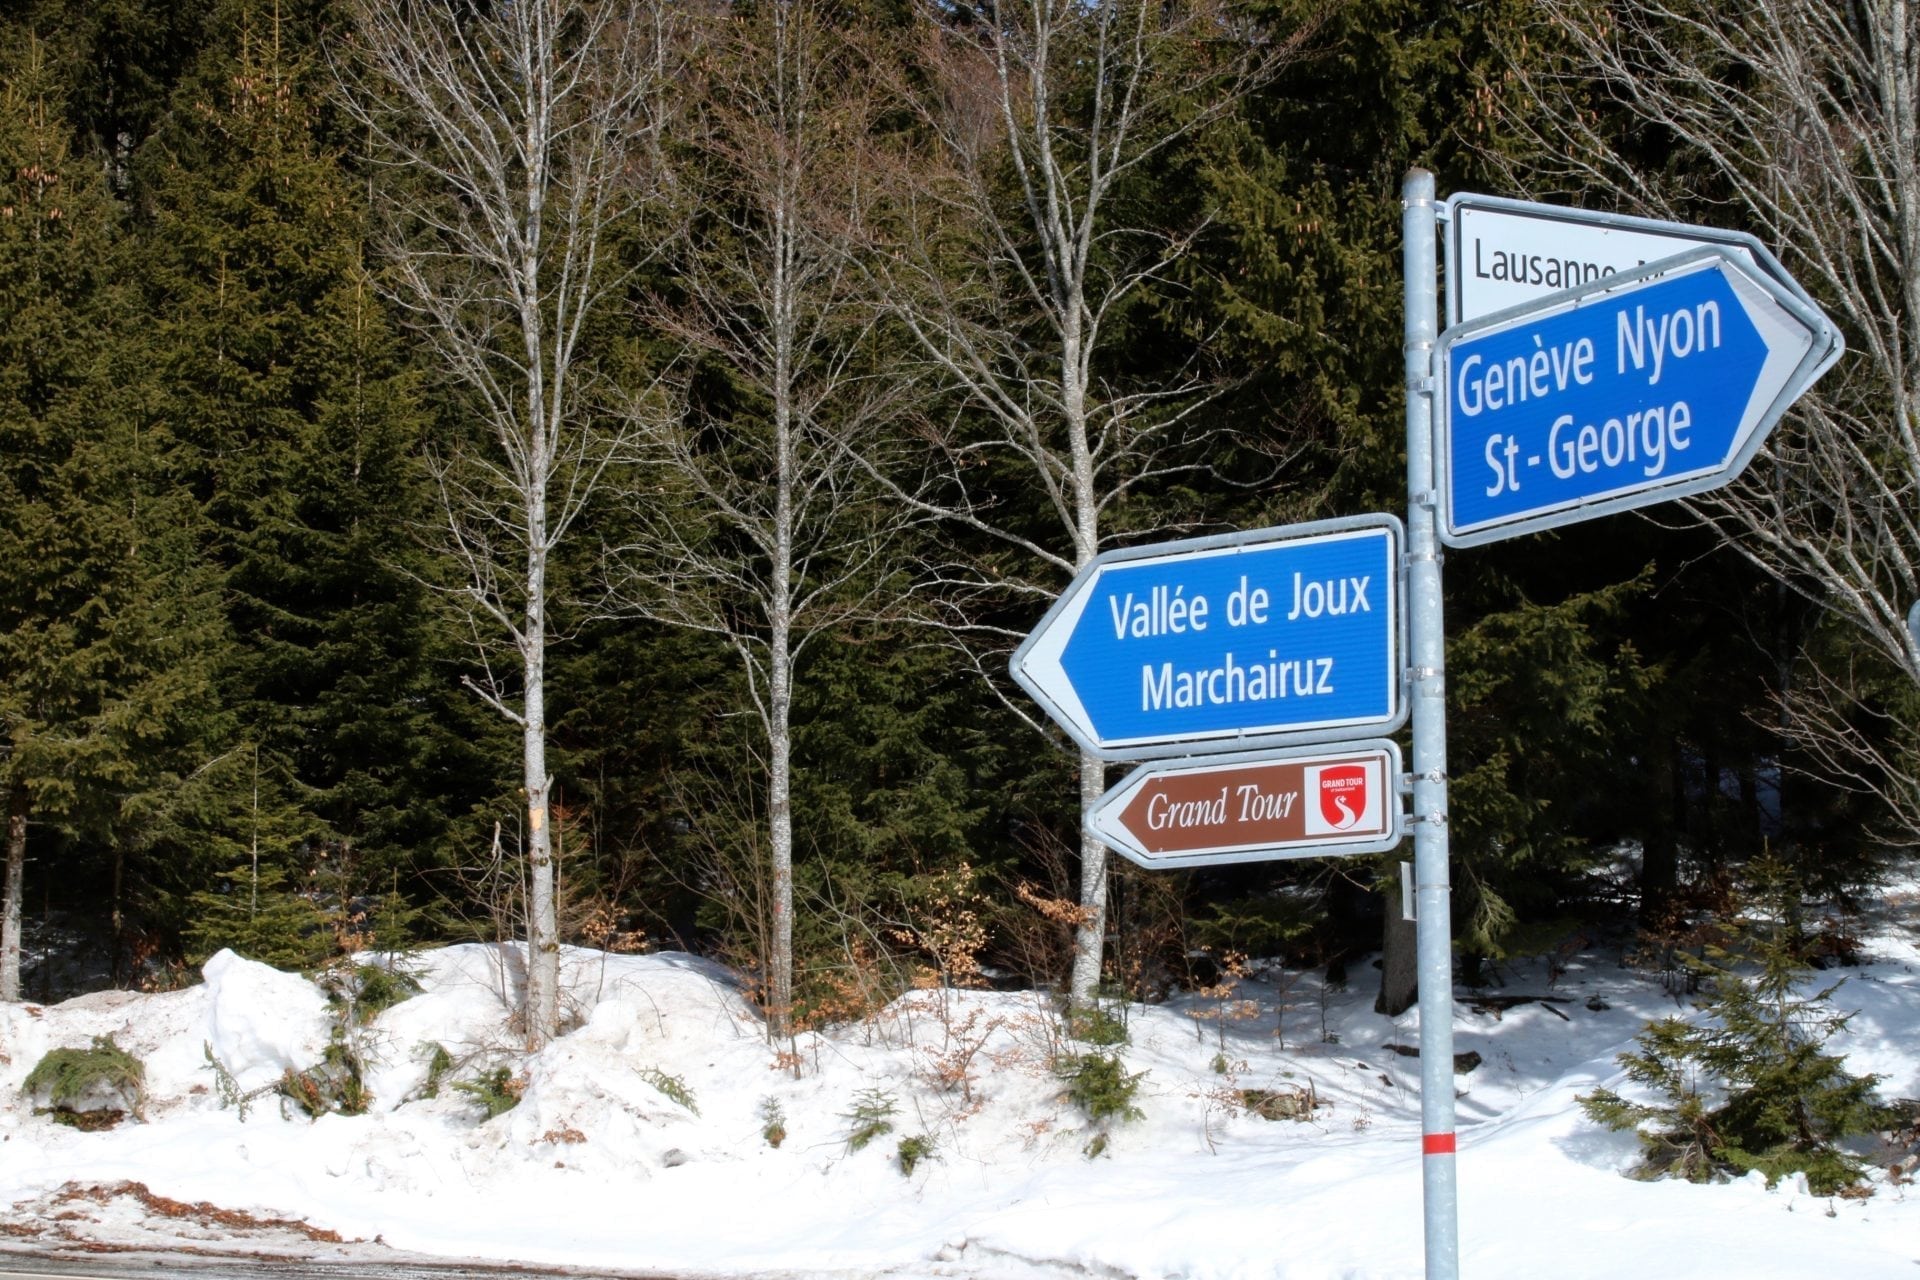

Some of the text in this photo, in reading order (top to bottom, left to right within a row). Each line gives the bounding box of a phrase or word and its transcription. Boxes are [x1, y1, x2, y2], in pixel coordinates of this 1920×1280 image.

[1458, 299, 1720, 417] Genève Nyon
[1109, 572, 1371, 640] Vallée de Joux
[1142, 649, 1334, 711] Marchairuz
[1147, 784, 1298, 830] Grand Tour
[1322, 777, 1364, 789] GRAND TOUR
